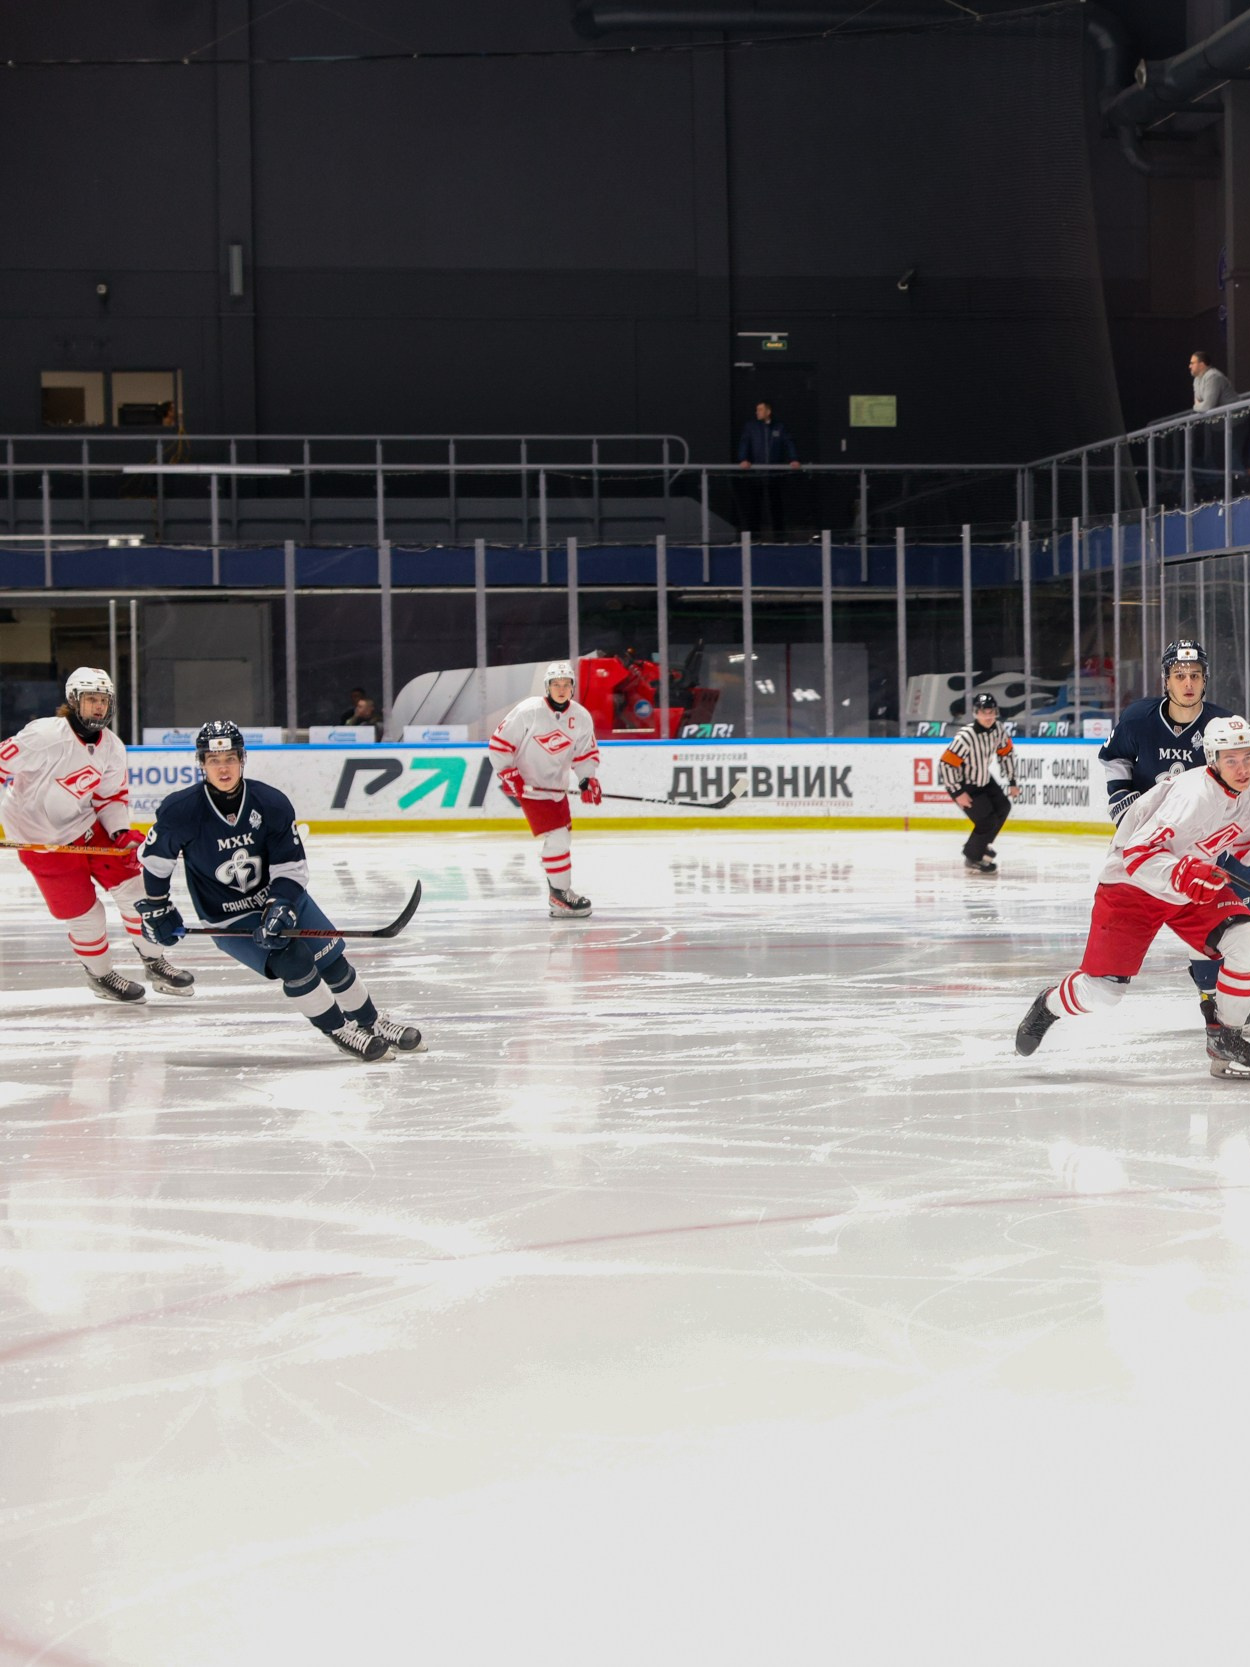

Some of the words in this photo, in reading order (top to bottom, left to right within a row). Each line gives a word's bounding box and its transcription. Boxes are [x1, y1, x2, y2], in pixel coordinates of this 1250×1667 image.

[682, 723, 734, 739] PARI
[1038, 722, 1069, 737] PARI
[1159, 748, 1193, 763] МХК
[1052, 757, 1090, 782] ФАСАДЫ
[667, 765, 854, 801] ДНЕВНИК
[1043, 784, 1090, 808] ВОДОСТОКИ
[216, 833, 255, 852] МХК
[141, 904, 177, 920] CCM
